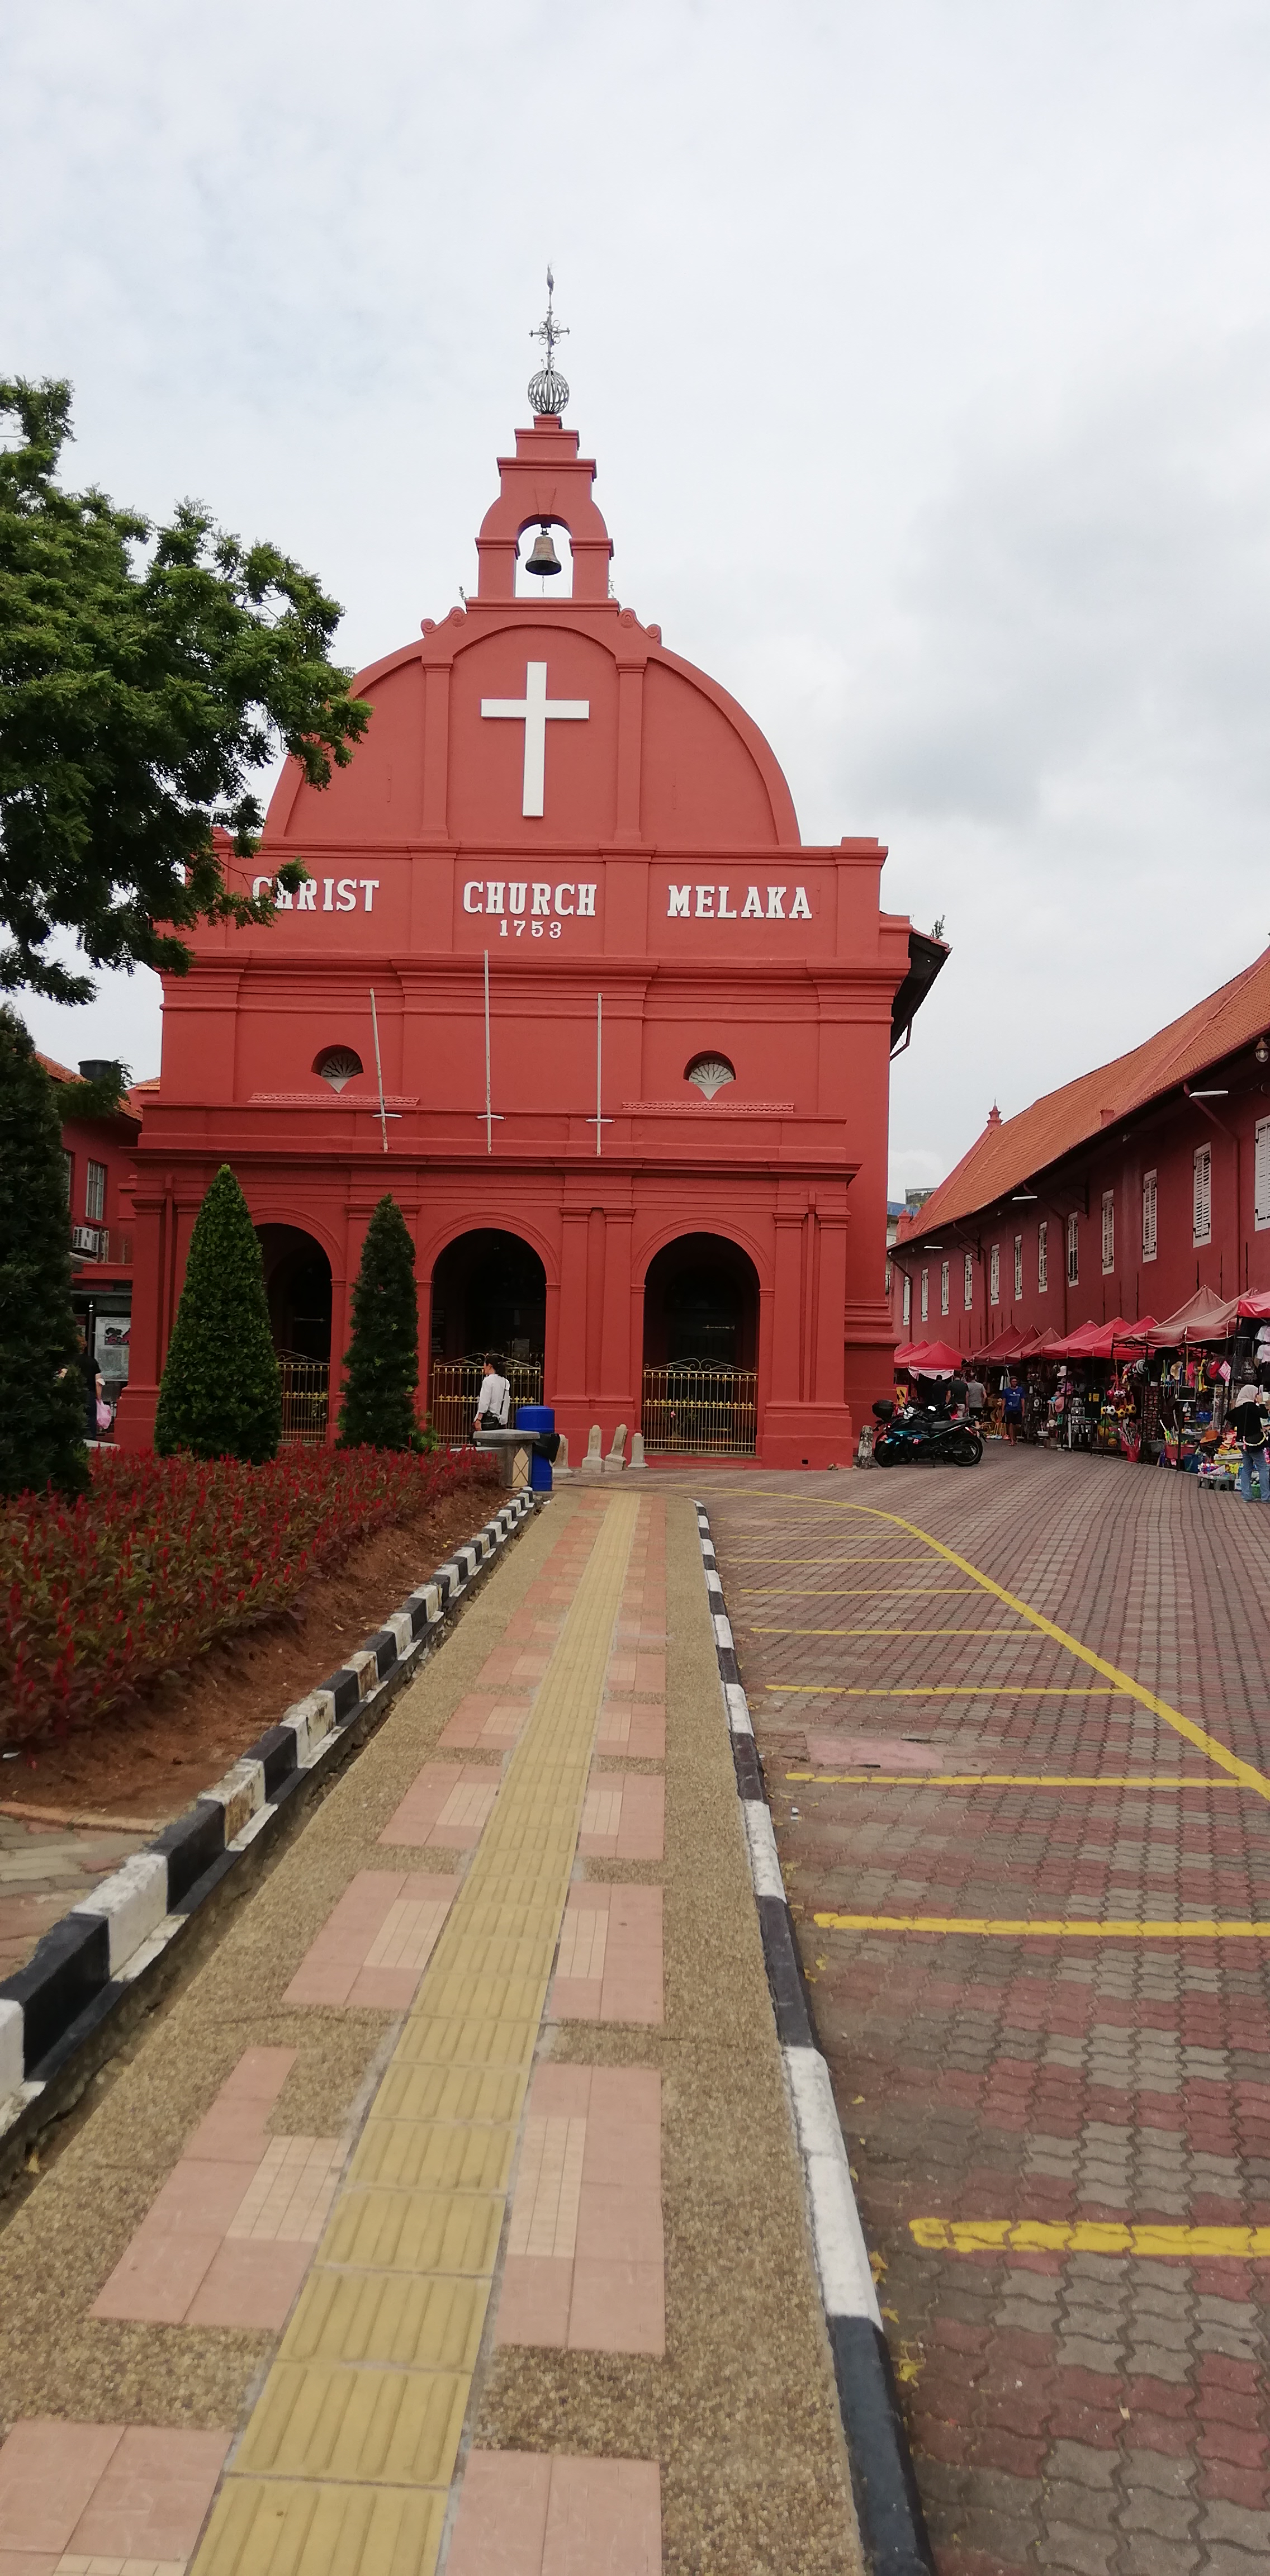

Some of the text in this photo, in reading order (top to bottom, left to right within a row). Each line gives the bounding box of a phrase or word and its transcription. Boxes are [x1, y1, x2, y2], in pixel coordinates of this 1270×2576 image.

[463, 881, 597, 916] CHURCH
[667, 885, 812, 919] MELAKA
[499, 919, 562, 939] 1753
